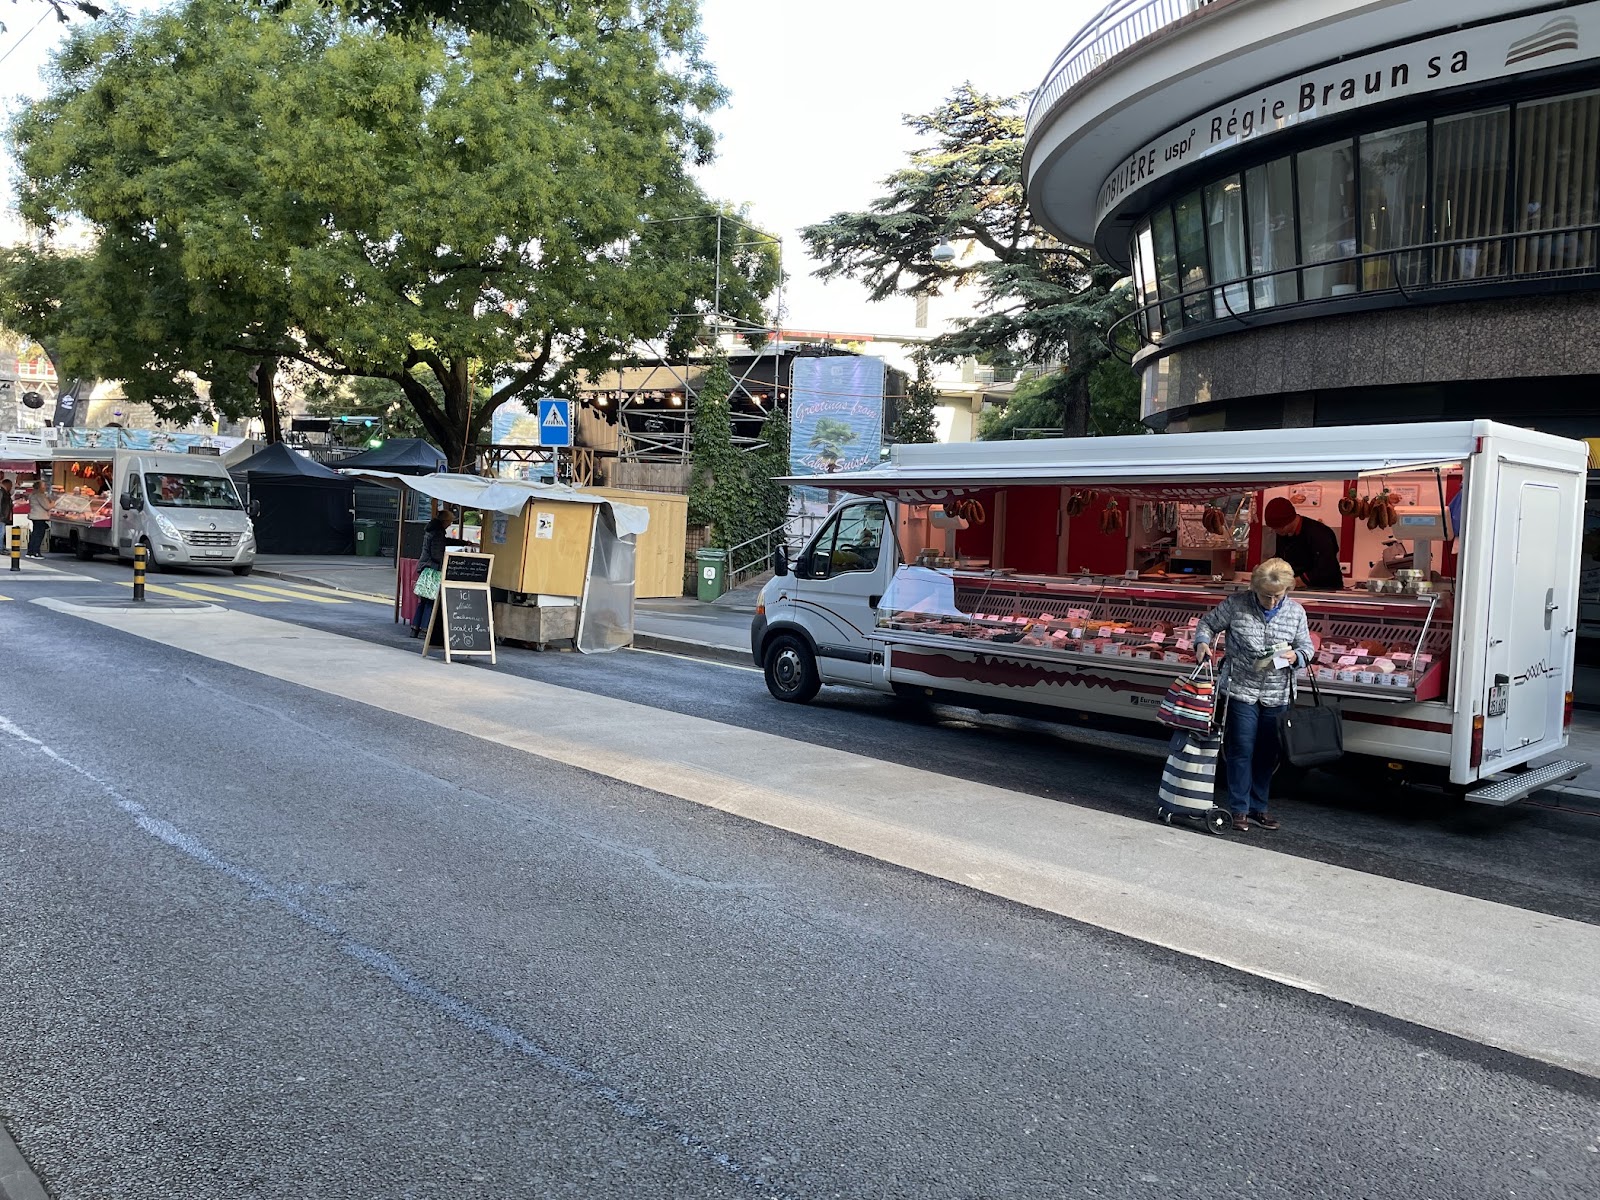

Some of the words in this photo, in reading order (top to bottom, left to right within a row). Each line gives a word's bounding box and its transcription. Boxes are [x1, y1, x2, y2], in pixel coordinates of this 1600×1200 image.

[1210, 98, 1285, 143] Régie
[1298, 63, 1409, 113] Braun
[1427, 50, 1468, 79] sa
[796, 400, 848, 423] Greetings
[850, 399, 877, 419] from
[798, 453, 830, 471] Label
